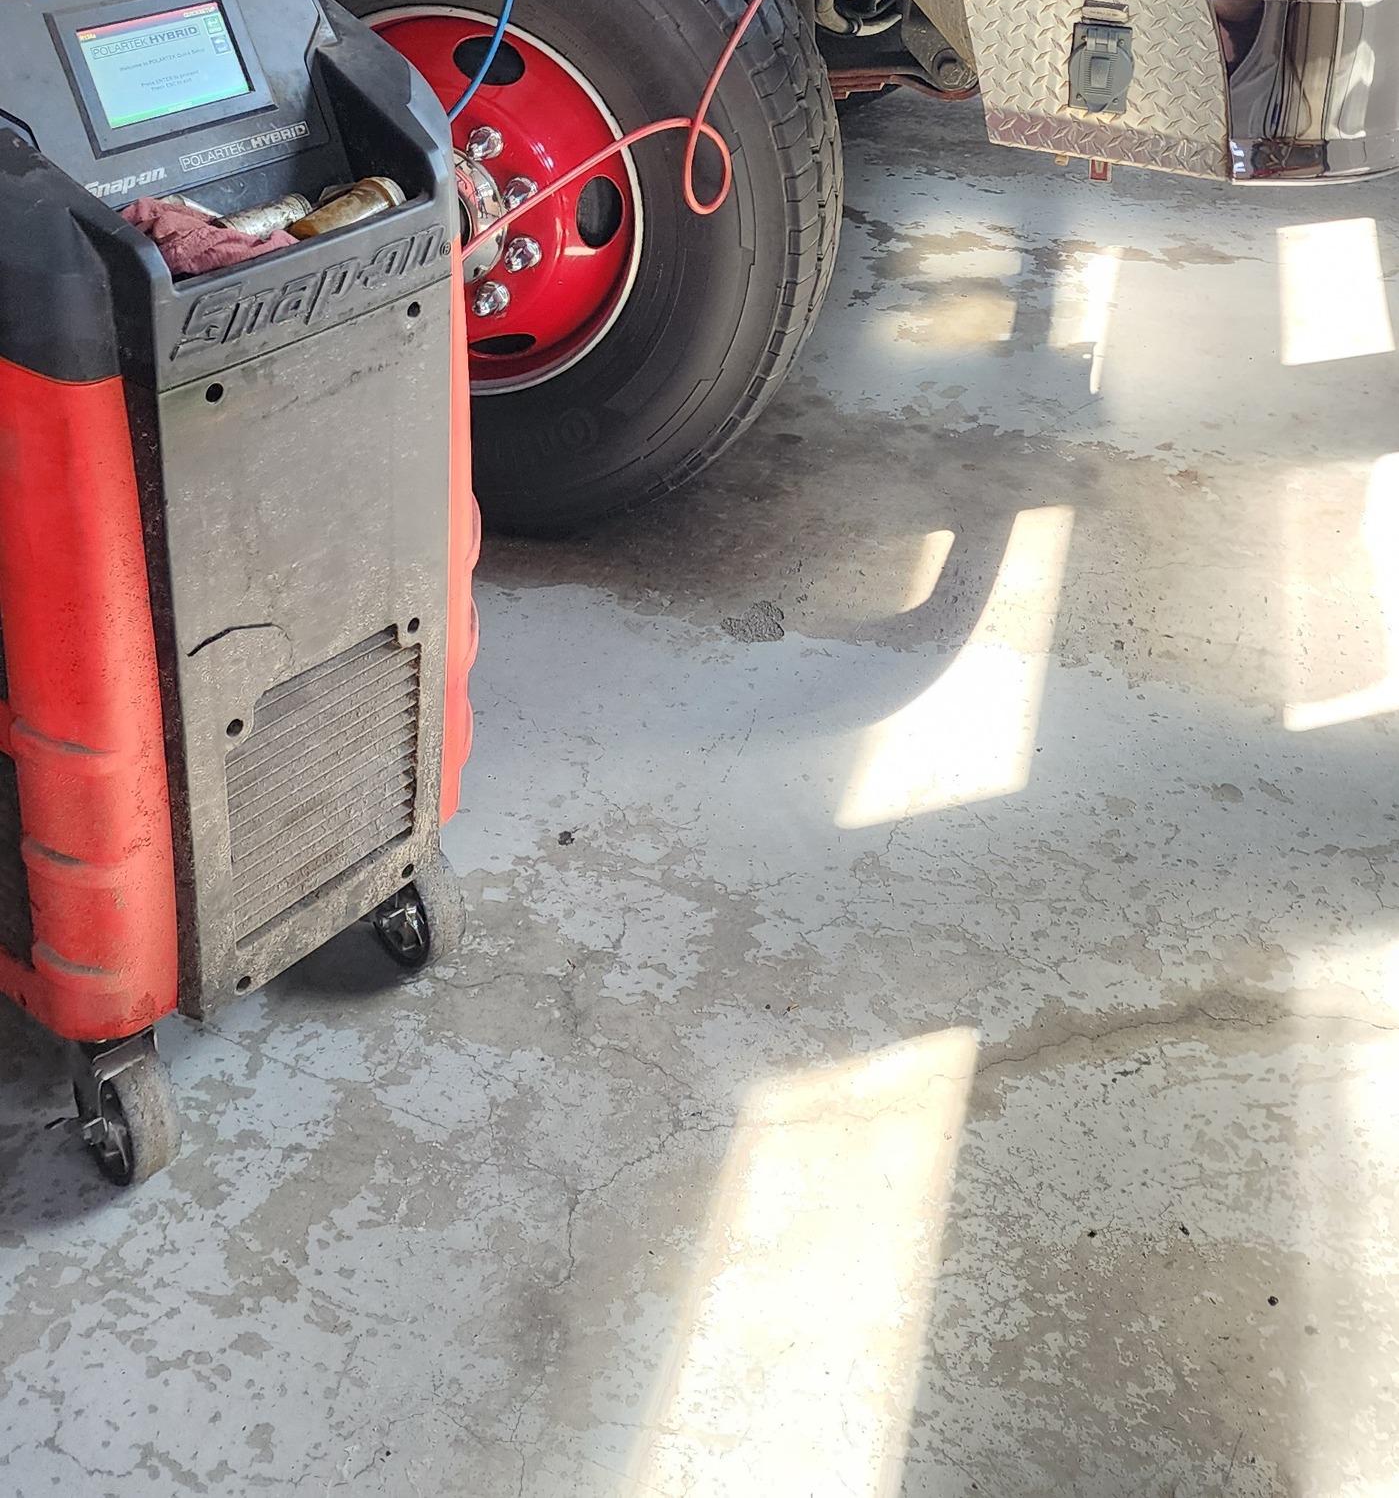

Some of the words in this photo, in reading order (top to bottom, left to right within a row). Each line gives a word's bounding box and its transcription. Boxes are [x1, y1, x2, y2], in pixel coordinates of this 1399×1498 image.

[93, 38, 149, 57] POLARTEK
[149, 26, 199, 45] HYBRID
[181, 140, 246, 169] POLARTEK
[249, 124, 307, 149] HYBRID
